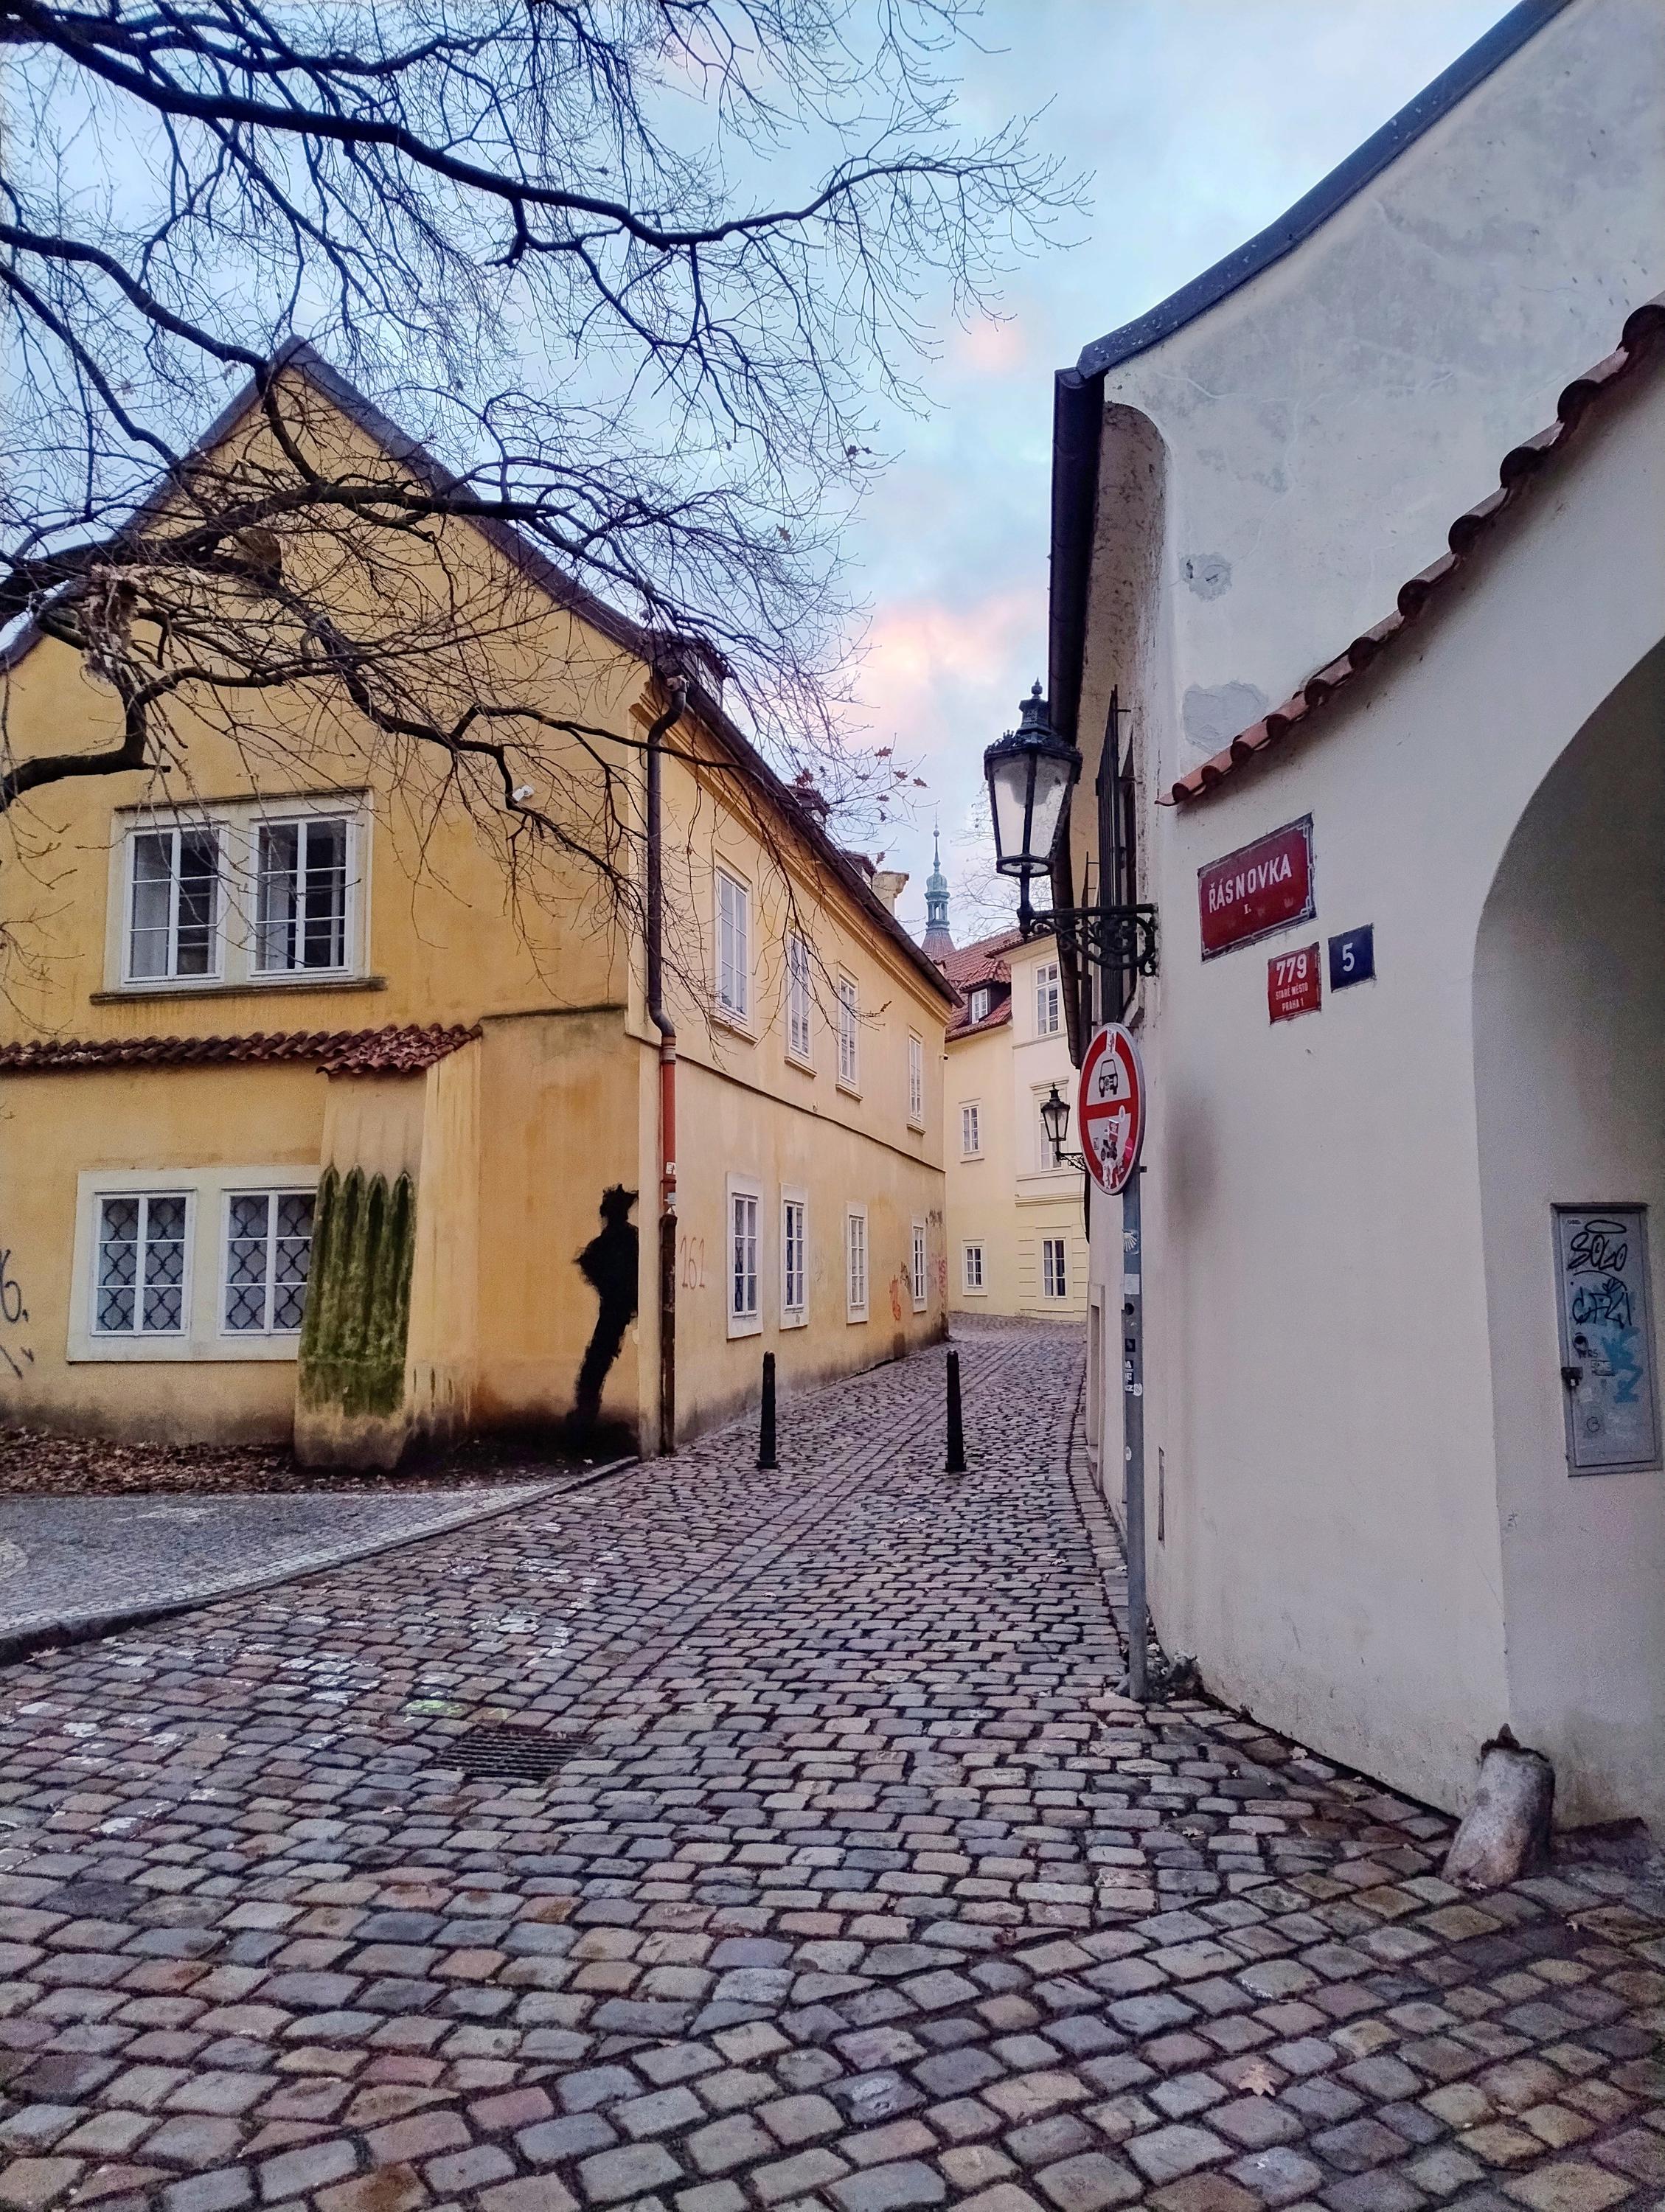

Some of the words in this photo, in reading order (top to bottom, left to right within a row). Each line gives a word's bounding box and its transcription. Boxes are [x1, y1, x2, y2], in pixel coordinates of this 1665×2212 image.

[1209, 853, 1292, 914] ŘÁSNOVKA
[1276, 953, 1307, 986] 779
[1342, 943, 1355, 972] 5
[1275, 985, 1290, 1000] STARÉ
[1282, 998, 1300, 1012] PRAHA
[1300, 998, 1304, 1006] 1
[681, 1235, 706, 1290] 161
